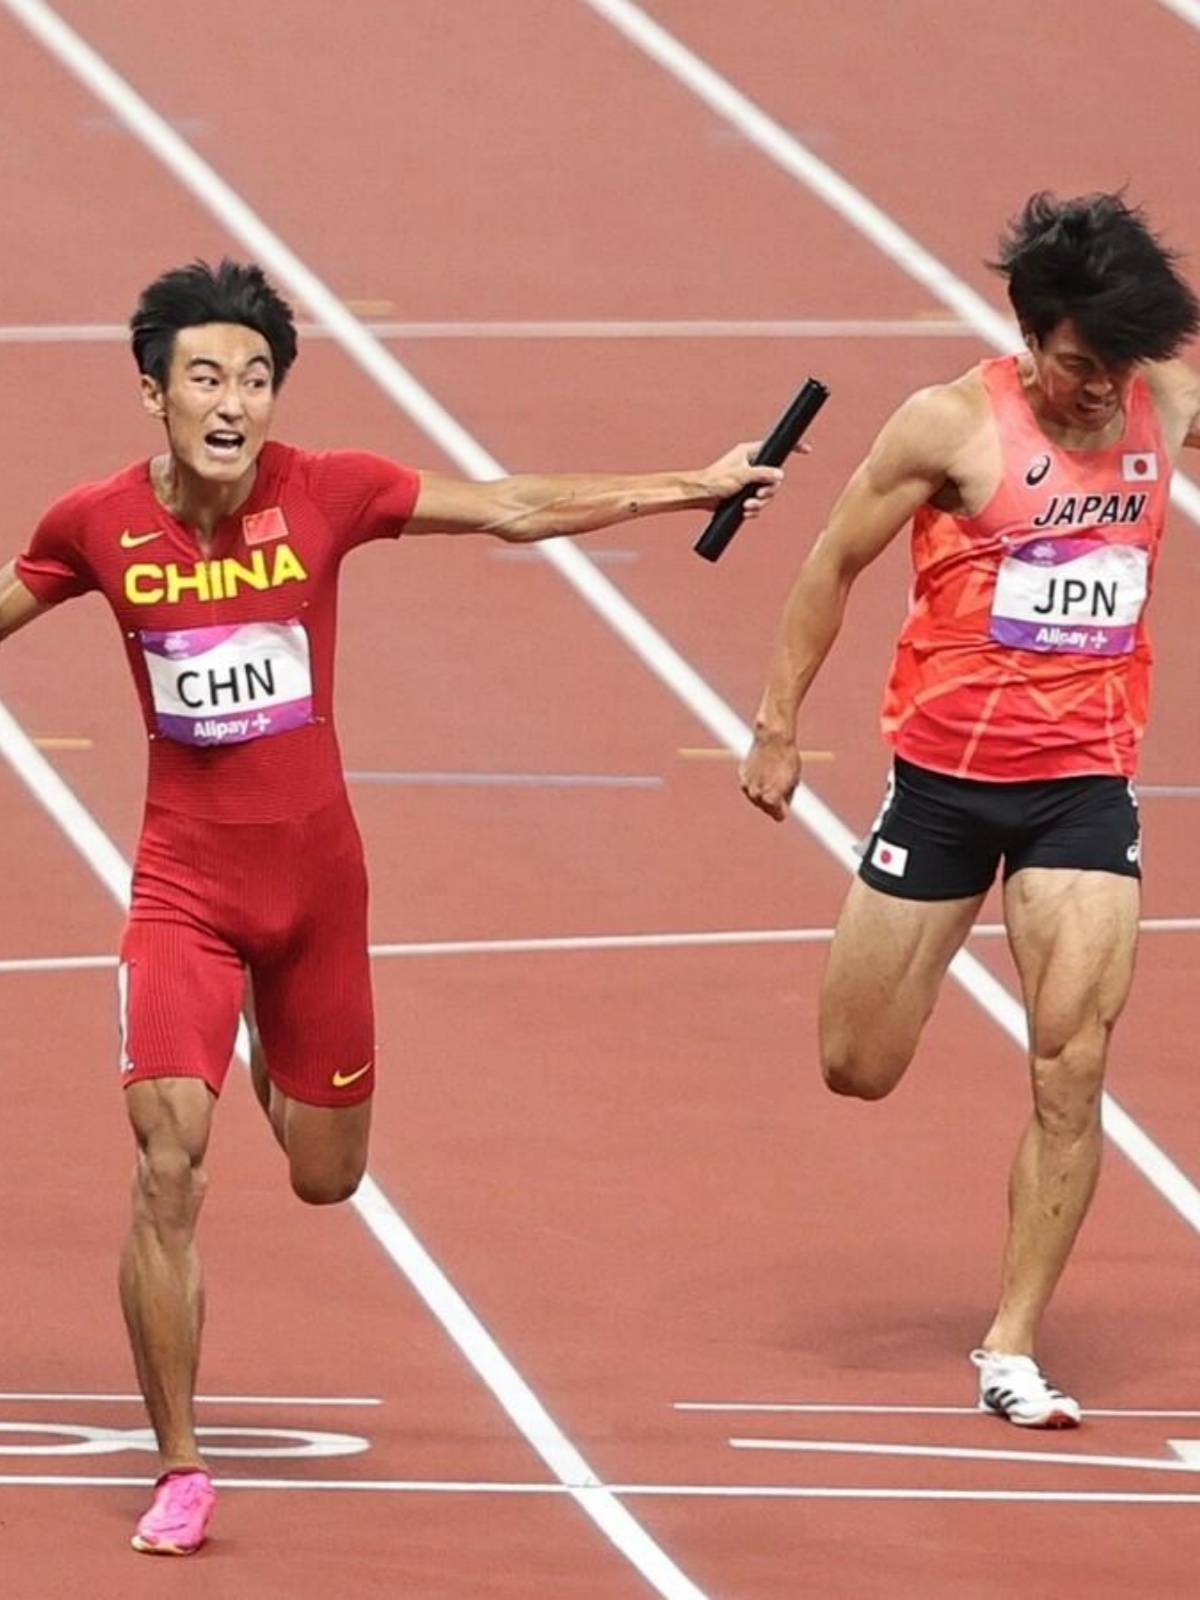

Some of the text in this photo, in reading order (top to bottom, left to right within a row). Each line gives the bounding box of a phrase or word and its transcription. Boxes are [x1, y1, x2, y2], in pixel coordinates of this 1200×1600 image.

[1032, 494, 1147, 527] JAPAN
[124, 543, 308, 604] CHINA
[1032, 577, 1118, 618] JPN
[176, 658, 276, 709] CHN
